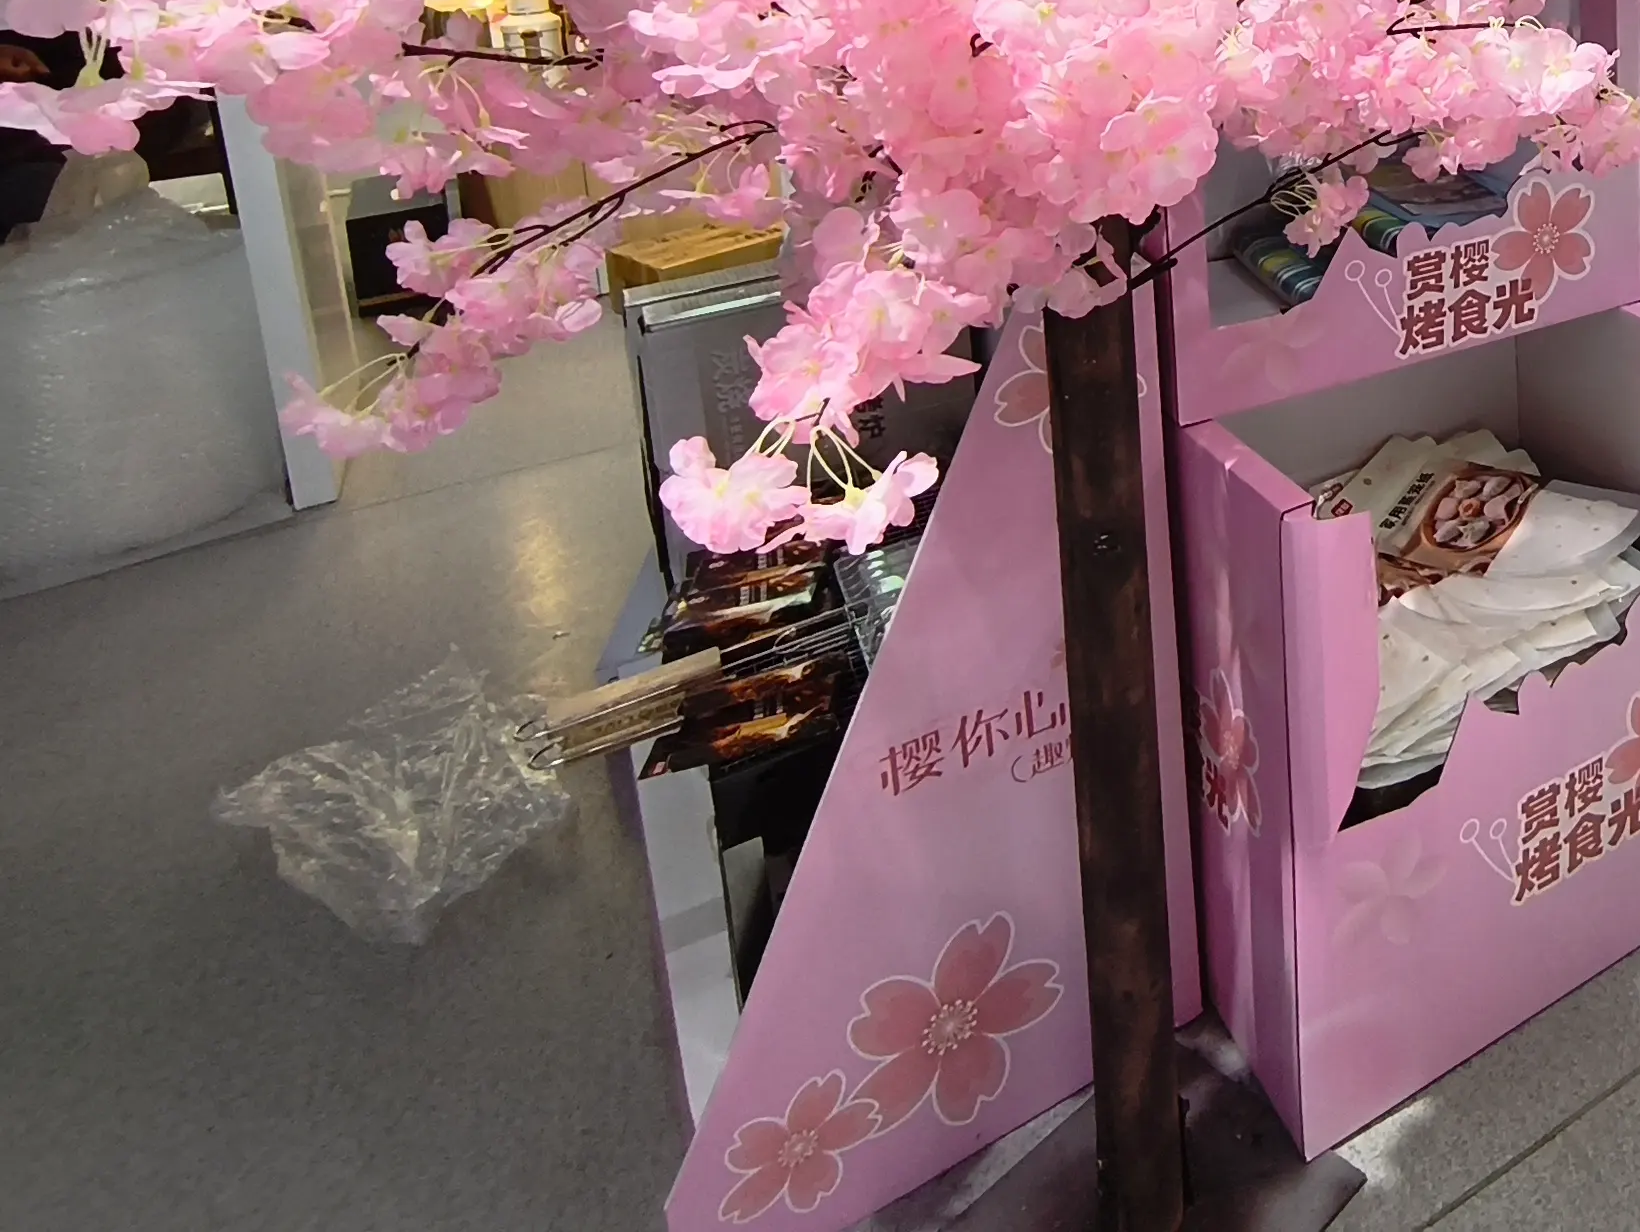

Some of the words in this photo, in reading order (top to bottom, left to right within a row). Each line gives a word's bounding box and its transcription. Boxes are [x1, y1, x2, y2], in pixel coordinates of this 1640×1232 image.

[1406, 237, 1491, 301] 赏樱
[1399, 277, 1537, 357] 烤食光
[1521, 755, 1604, 846] 赏樱
